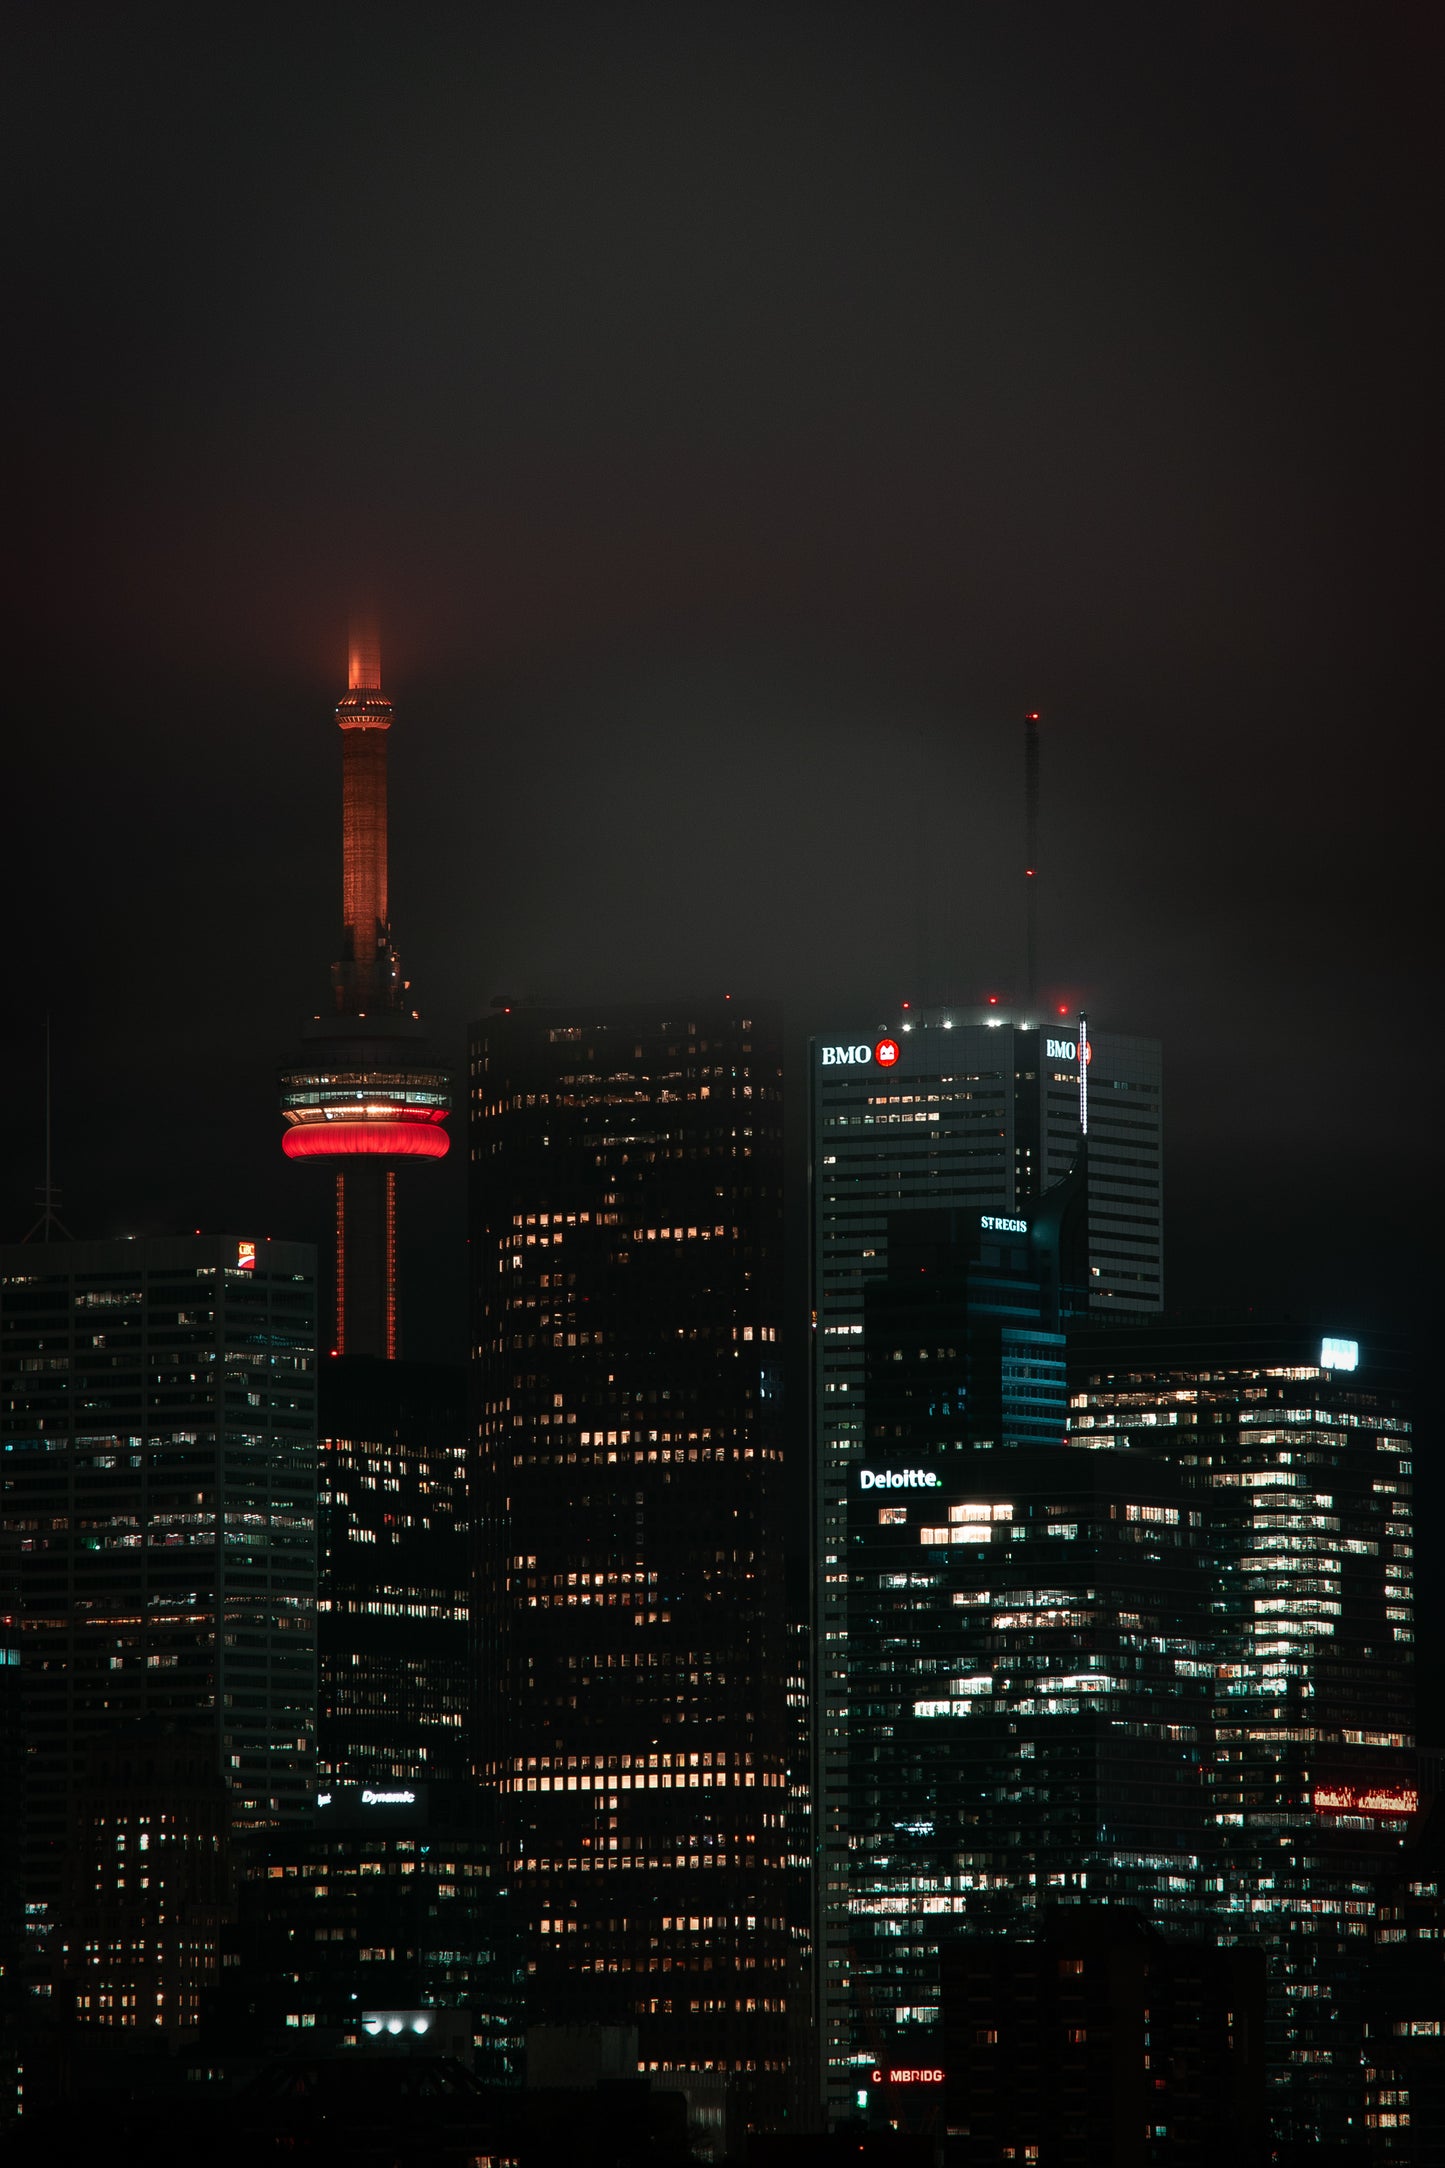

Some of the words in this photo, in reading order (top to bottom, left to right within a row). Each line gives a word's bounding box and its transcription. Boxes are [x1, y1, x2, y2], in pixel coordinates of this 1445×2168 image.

[822, 1045, 872, 1065] BMO
[1047, 1039, 1076, 1060] BMO
[995, 1217, 1028, 1232] REGIS
[361, 1790, 416, 1805] Dynamic
